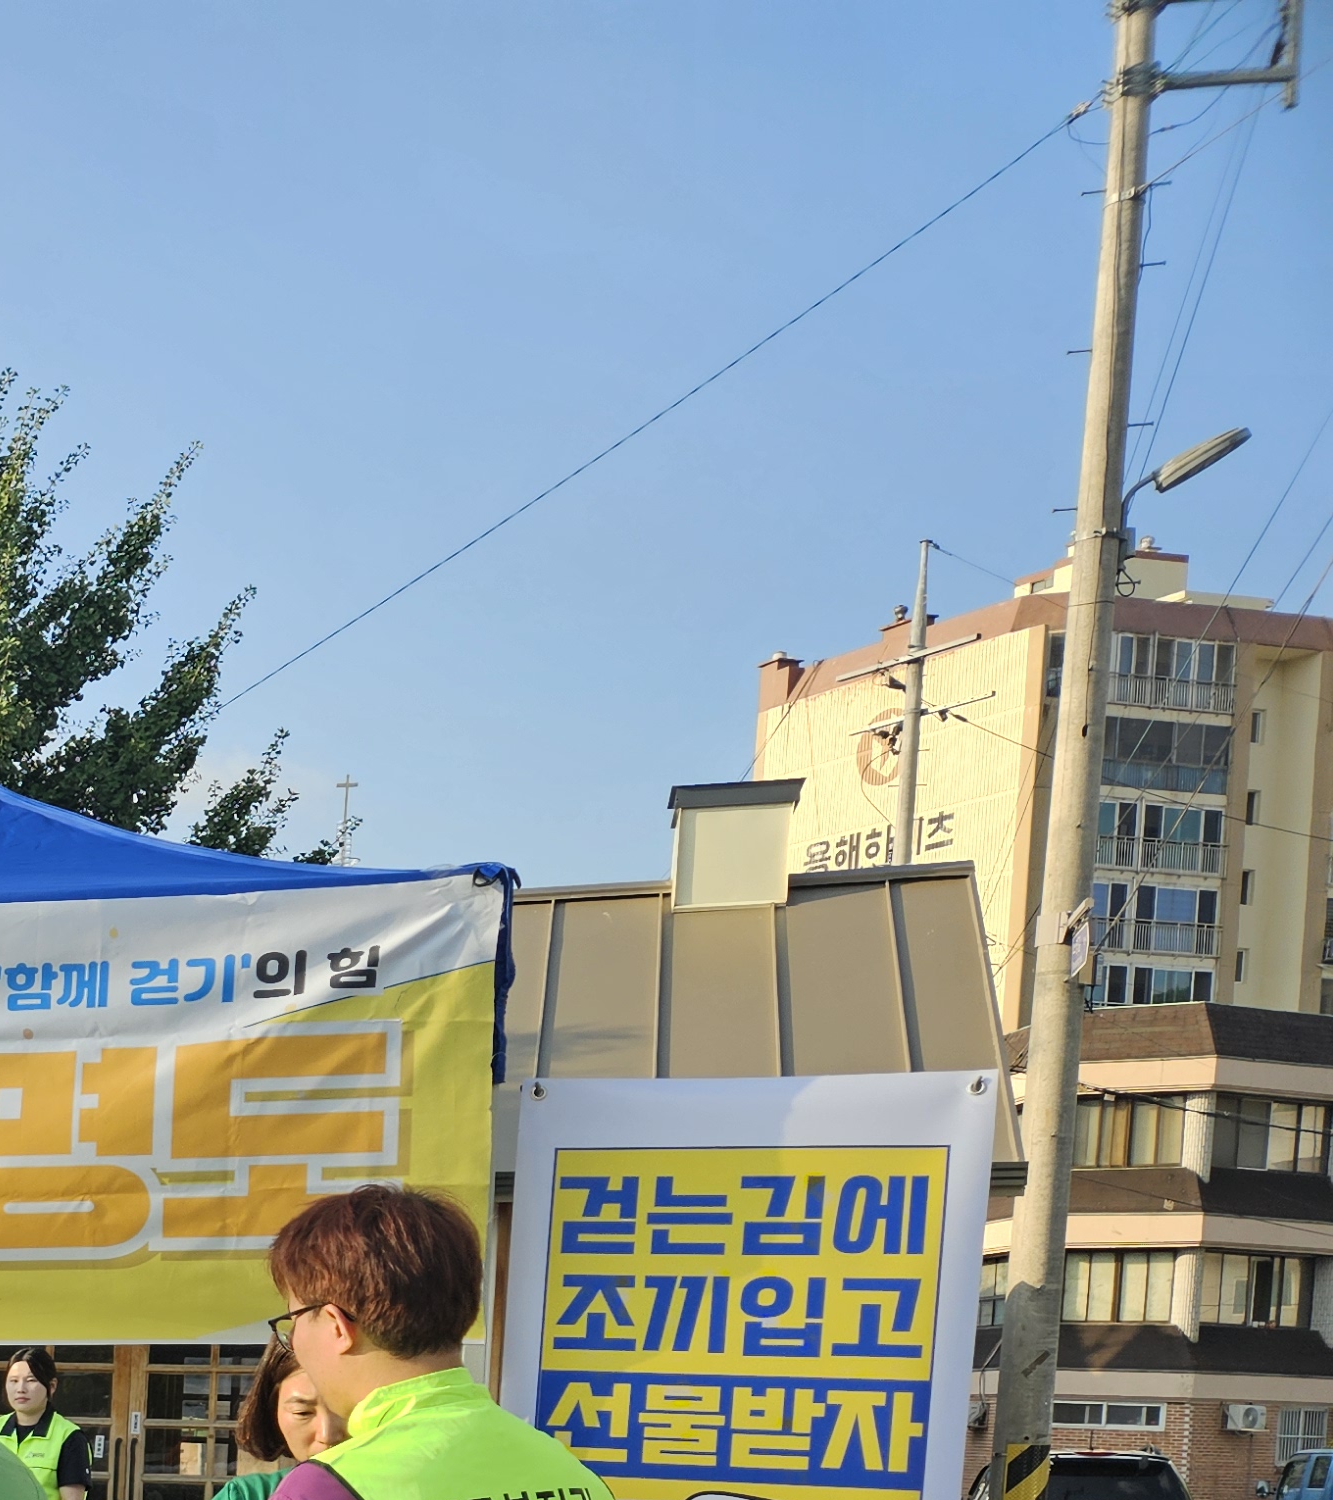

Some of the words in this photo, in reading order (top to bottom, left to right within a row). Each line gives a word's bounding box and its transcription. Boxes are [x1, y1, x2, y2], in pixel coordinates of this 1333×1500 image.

[129, 949, 307, 1009] 걷기'의
[326, 945, 381, 990] 힘
[557, 1173, 930, 1257] 걷는김에
[552, 1274, 923, 1359] 조끼입고
[546, 1381, 924, 1474] 선물받자
